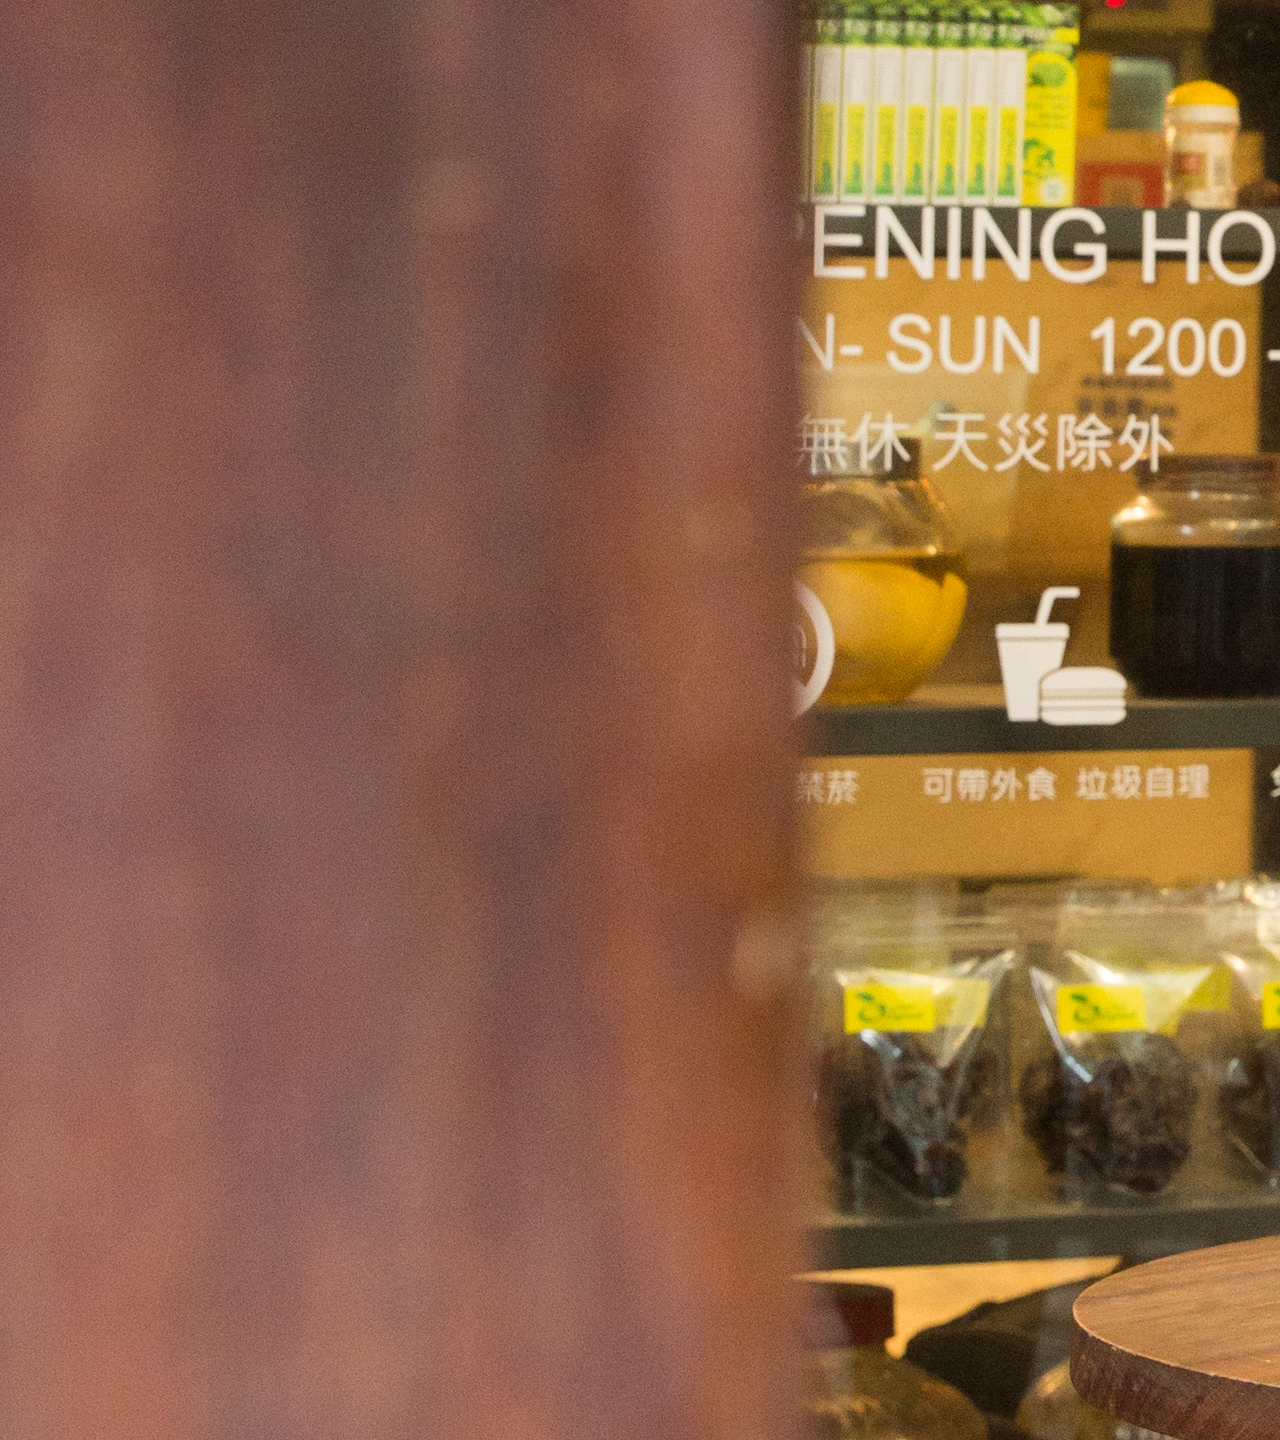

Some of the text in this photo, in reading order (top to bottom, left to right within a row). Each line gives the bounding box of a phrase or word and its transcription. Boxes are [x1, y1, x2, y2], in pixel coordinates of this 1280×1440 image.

[811, 203, 1108, 285] ENING
[886, 313, 1040, 375] SUN
[1090, 316, 1248, 378] 1200
[932, 412, 1176, 474] 天災除外
[921, 766, 1059, 804] 可帶外食
[1076, 763, 1210, 801] 垃圾自理
